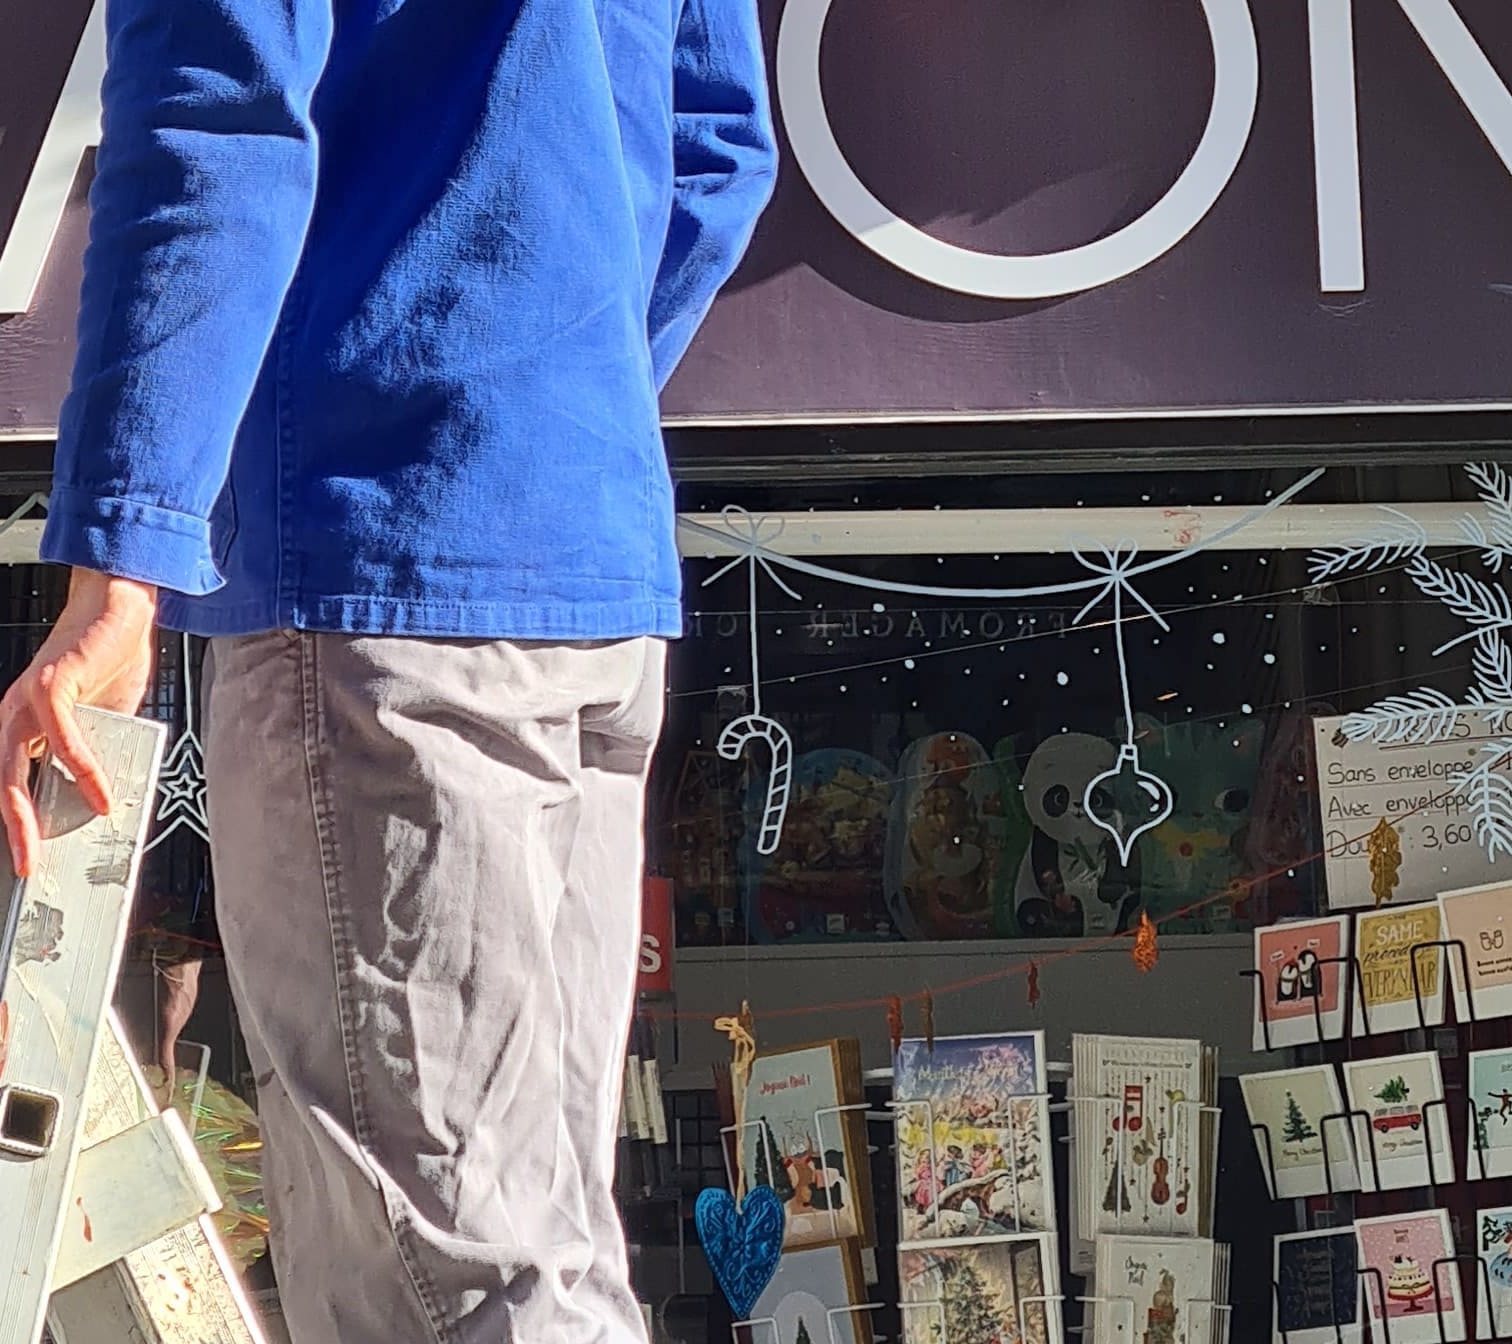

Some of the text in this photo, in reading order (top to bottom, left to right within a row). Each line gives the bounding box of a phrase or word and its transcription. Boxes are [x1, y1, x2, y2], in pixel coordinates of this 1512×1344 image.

[1327, 761, 1377, 785] Sans
[1327, 795, 1372, 818] Avec
[1421, 822, 1473, 851] 3,60
[1375, 920, 1424, 946] SAME
